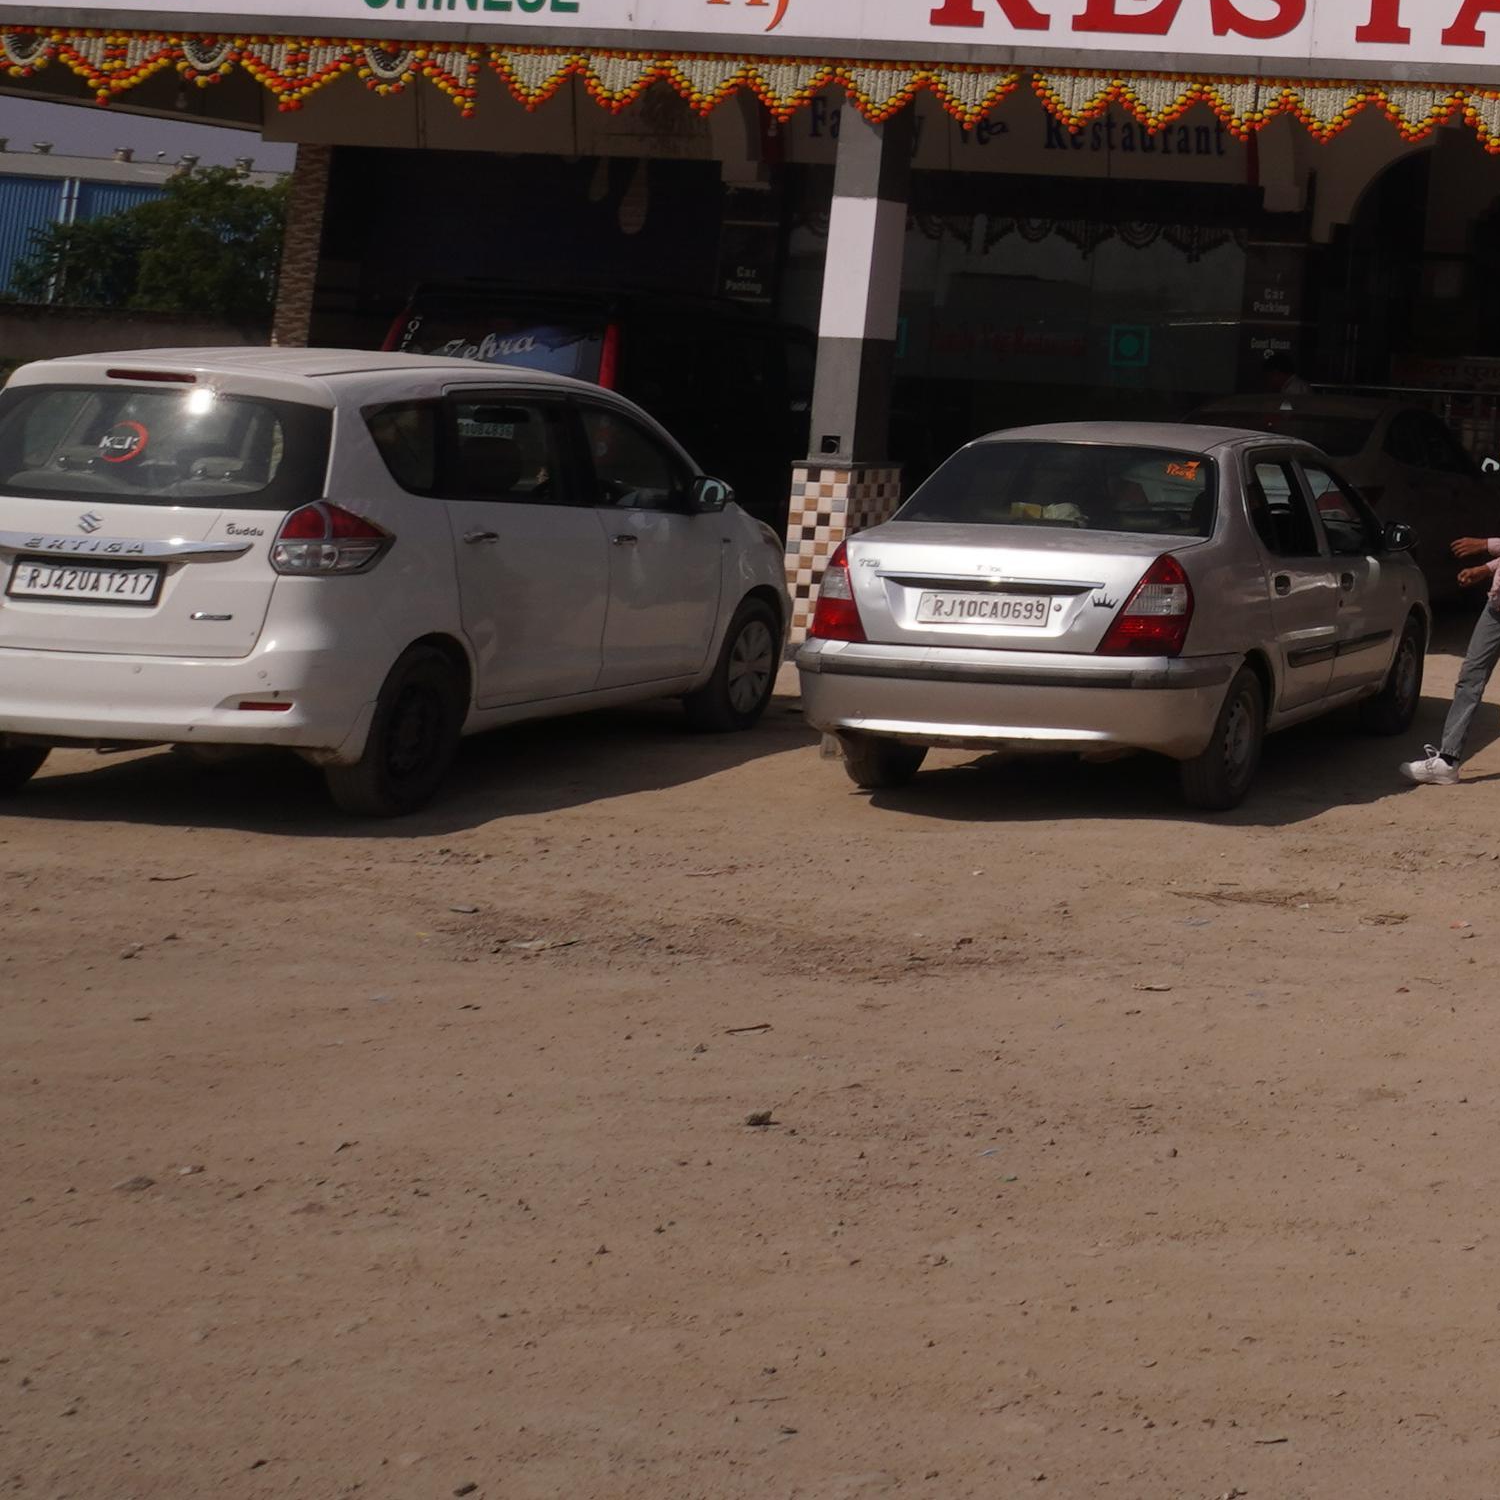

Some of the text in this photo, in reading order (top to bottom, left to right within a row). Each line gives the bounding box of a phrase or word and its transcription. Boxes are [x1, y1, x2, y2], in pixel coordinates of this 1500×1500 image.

[1043, 107, 1226, 156] Restaurant
[1264, 288, 1285, 300] Car
[1253, 301, 1290, 316] Parking
[24, 537, 146, 554] ERTIGA
[26, 568, 154, 596] RJ42UA1217
[931, 600, 1045, 620] RJ10CA0699
